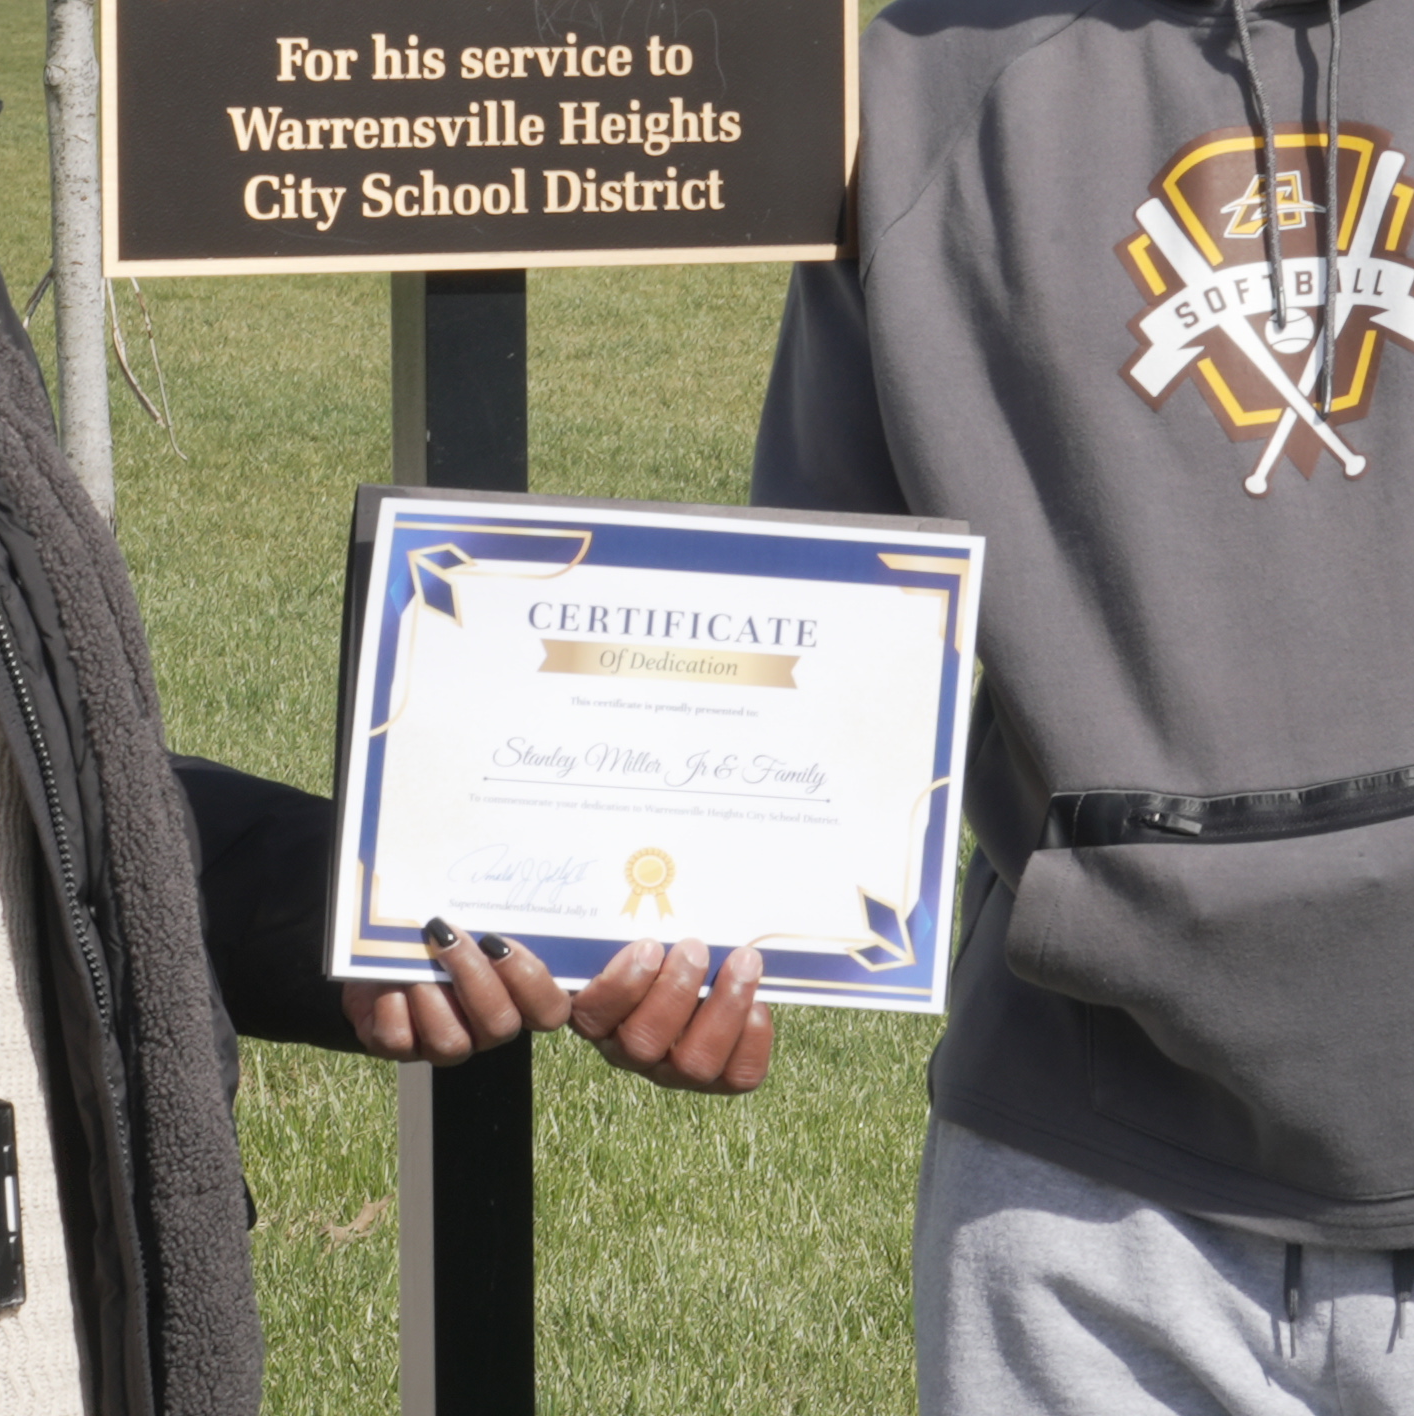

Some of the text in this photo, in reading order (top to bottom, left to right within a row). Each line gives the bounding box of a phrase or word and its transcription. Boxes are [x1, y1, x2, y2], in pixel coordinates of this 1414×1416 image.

[276, 32, 693, 82] For his service to
[226, 96, 742, 156] Warrensville Heights
[243, 166, 725, 232] City School District
[527, 601, 818, 647] CERTIFICATE
[599, 648, 739, 676] Of Dedication
[570, 696, 590, 706] This
[593, 697, 642, 709] certificate
[644, 701, 653, 709] is
[654, 702, 691, 715] proudly
[694, 705, 744, 717] presented
[492, 736, 827, 795] Stanley Miller Jr & Family
[468, 793, 481, 802] To
[483, 795, 552, 807] commemorate
[555, 800, 578, 810] your
[580, 799, 630, 812] dedication
[632, 804, 642, 812] to
[644, 803, 705, 816] Warrensville
[707, 808, 744, 821] Heights
[746, 810, 766, 823] City
[769, 811, 802, 823] School
[564, 905, 587, 918] Jolly
[589, 907, 599, 918] II
